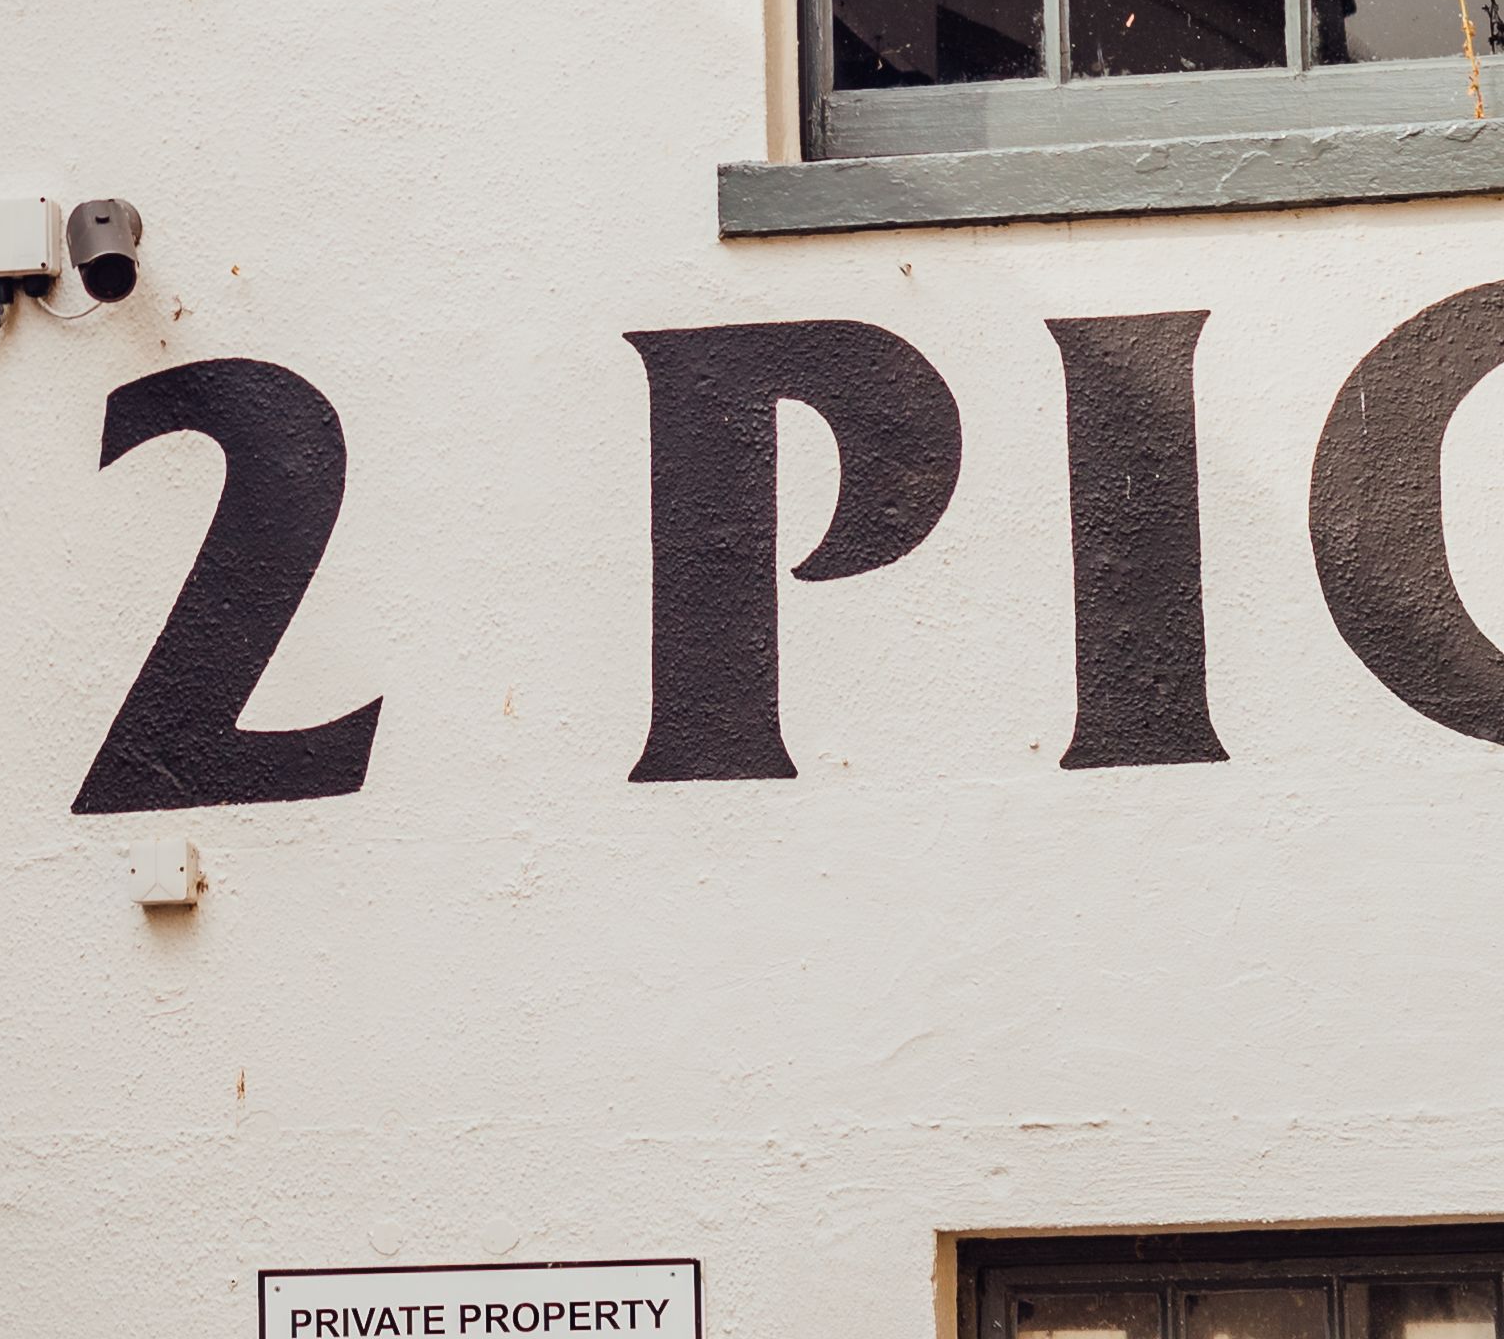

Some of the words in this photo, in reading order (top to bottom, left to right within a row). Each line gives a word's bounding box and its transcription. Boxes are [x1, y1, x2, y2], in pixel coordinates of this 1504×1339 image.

[70, 356, 385, 816] 2
[291, 1305, 446, 1339] PRIVATE
[459, 1298, 670, 1334] PROPERTY
